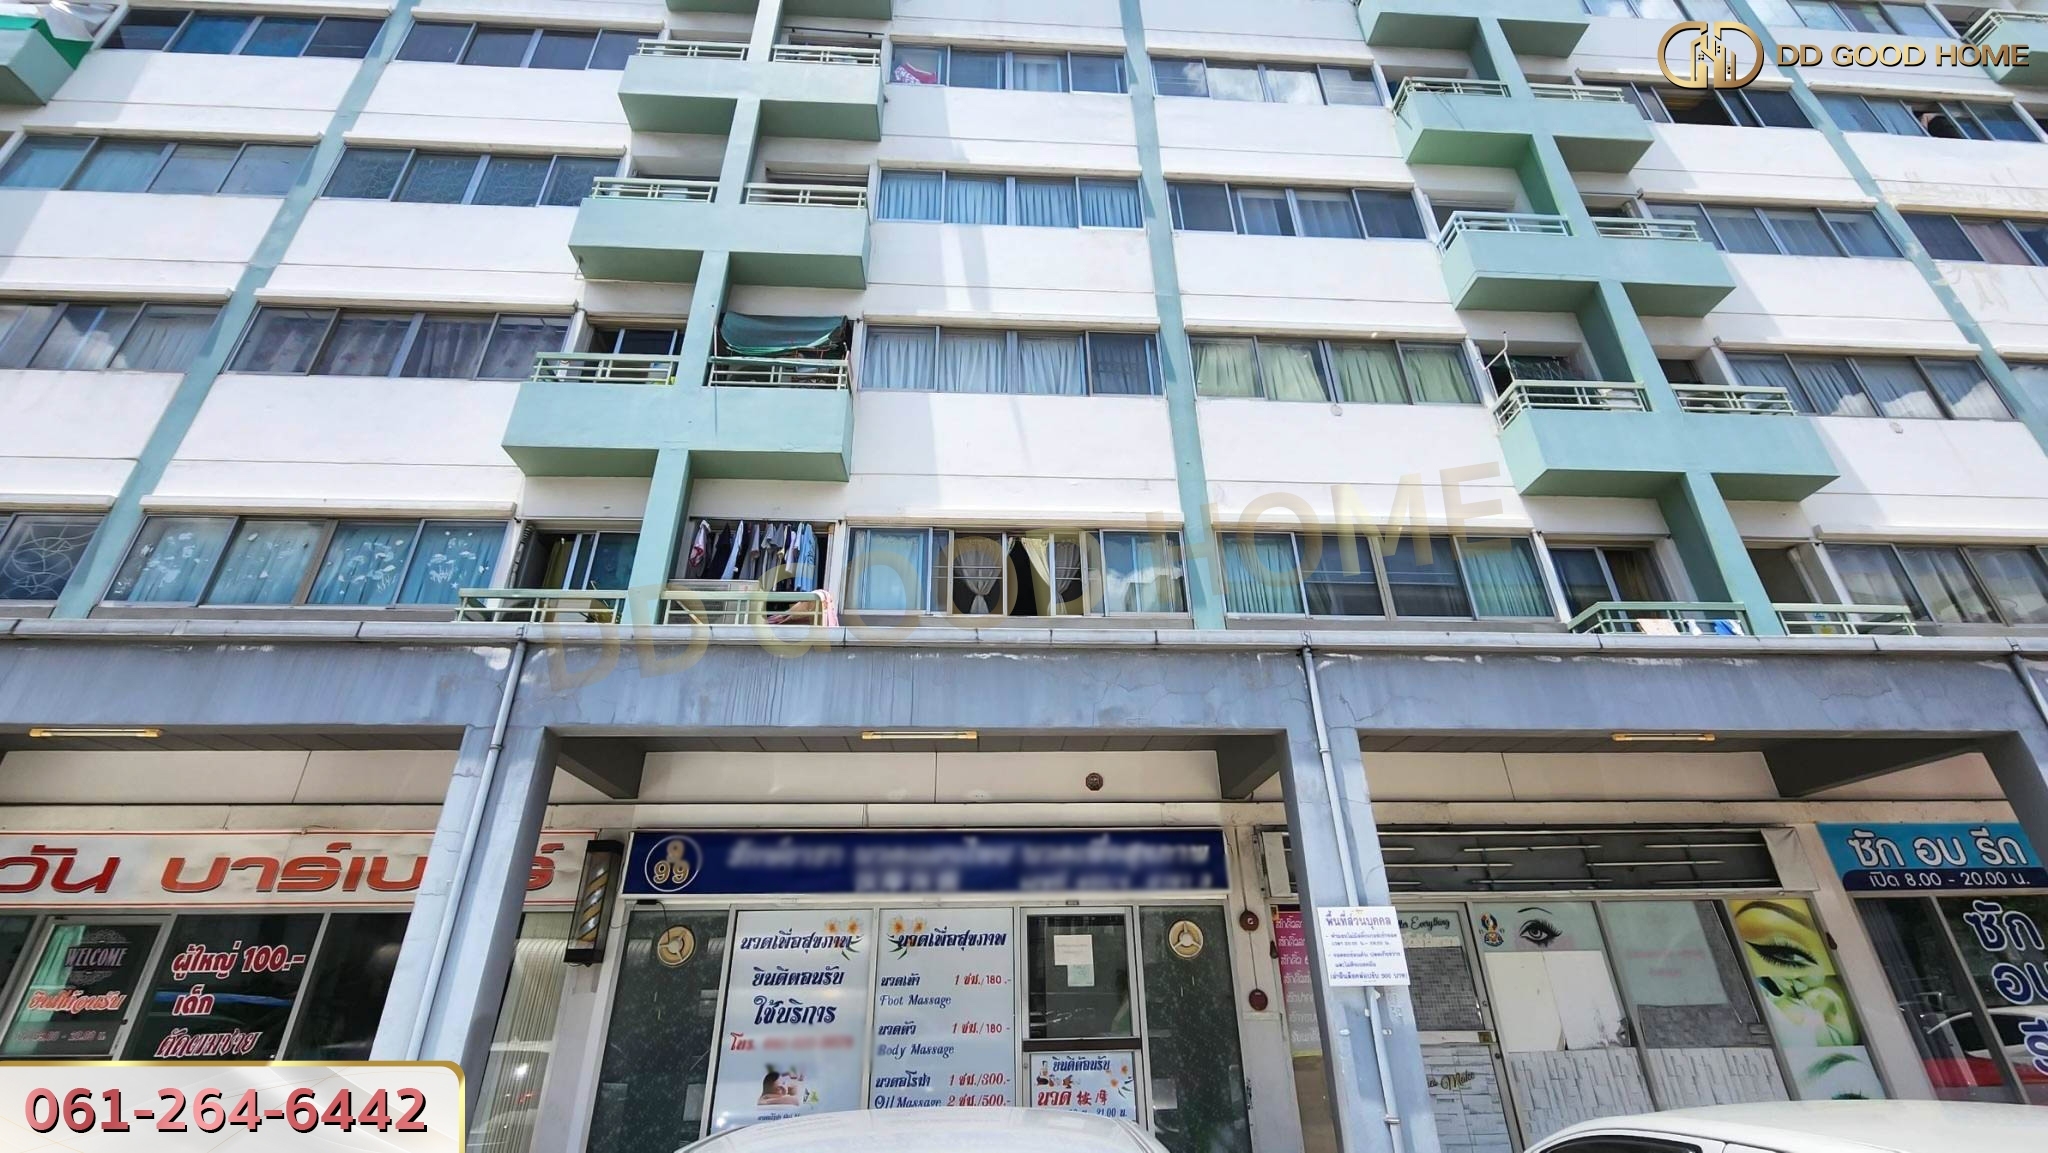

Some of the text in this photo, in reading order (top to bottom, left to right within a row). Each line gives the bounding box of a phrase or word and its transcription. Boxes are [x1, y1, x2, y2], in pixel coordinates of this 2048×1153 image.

[1847, 825, 2029, 868] ซัก อบ รีด
[1869, 871, 1901, 887] เปิด
[1904, 872, 1943, 887] 8.00
[1960, 871, 2008, 886] 20.00
[2011, 873, 2031, 886] น.
[1963, 900, 2046, 951] ซัก
[740, 928, 854, 954] นวดเพื่อสุขภาพ
[897, 926, 1007, 951] นวดเพื่อสุขภาพ
[65, 947, 128, 967] WELCOME
[171, 940, 307, 981] ผู้ใหญ่ 100.-
[172, 984, 215, 1016] เด็ก
[753, 995, 838, 1025] ใช้บริการ
[880, 994, 952, 1009] Foot Massage
[877, 1044, 955, 1060] Body Massage
[874, 1095, 895, 1109] Oil
[946, 1095, 956, 1107] 2
[1037, 1091, 1072, 1107] นวด
